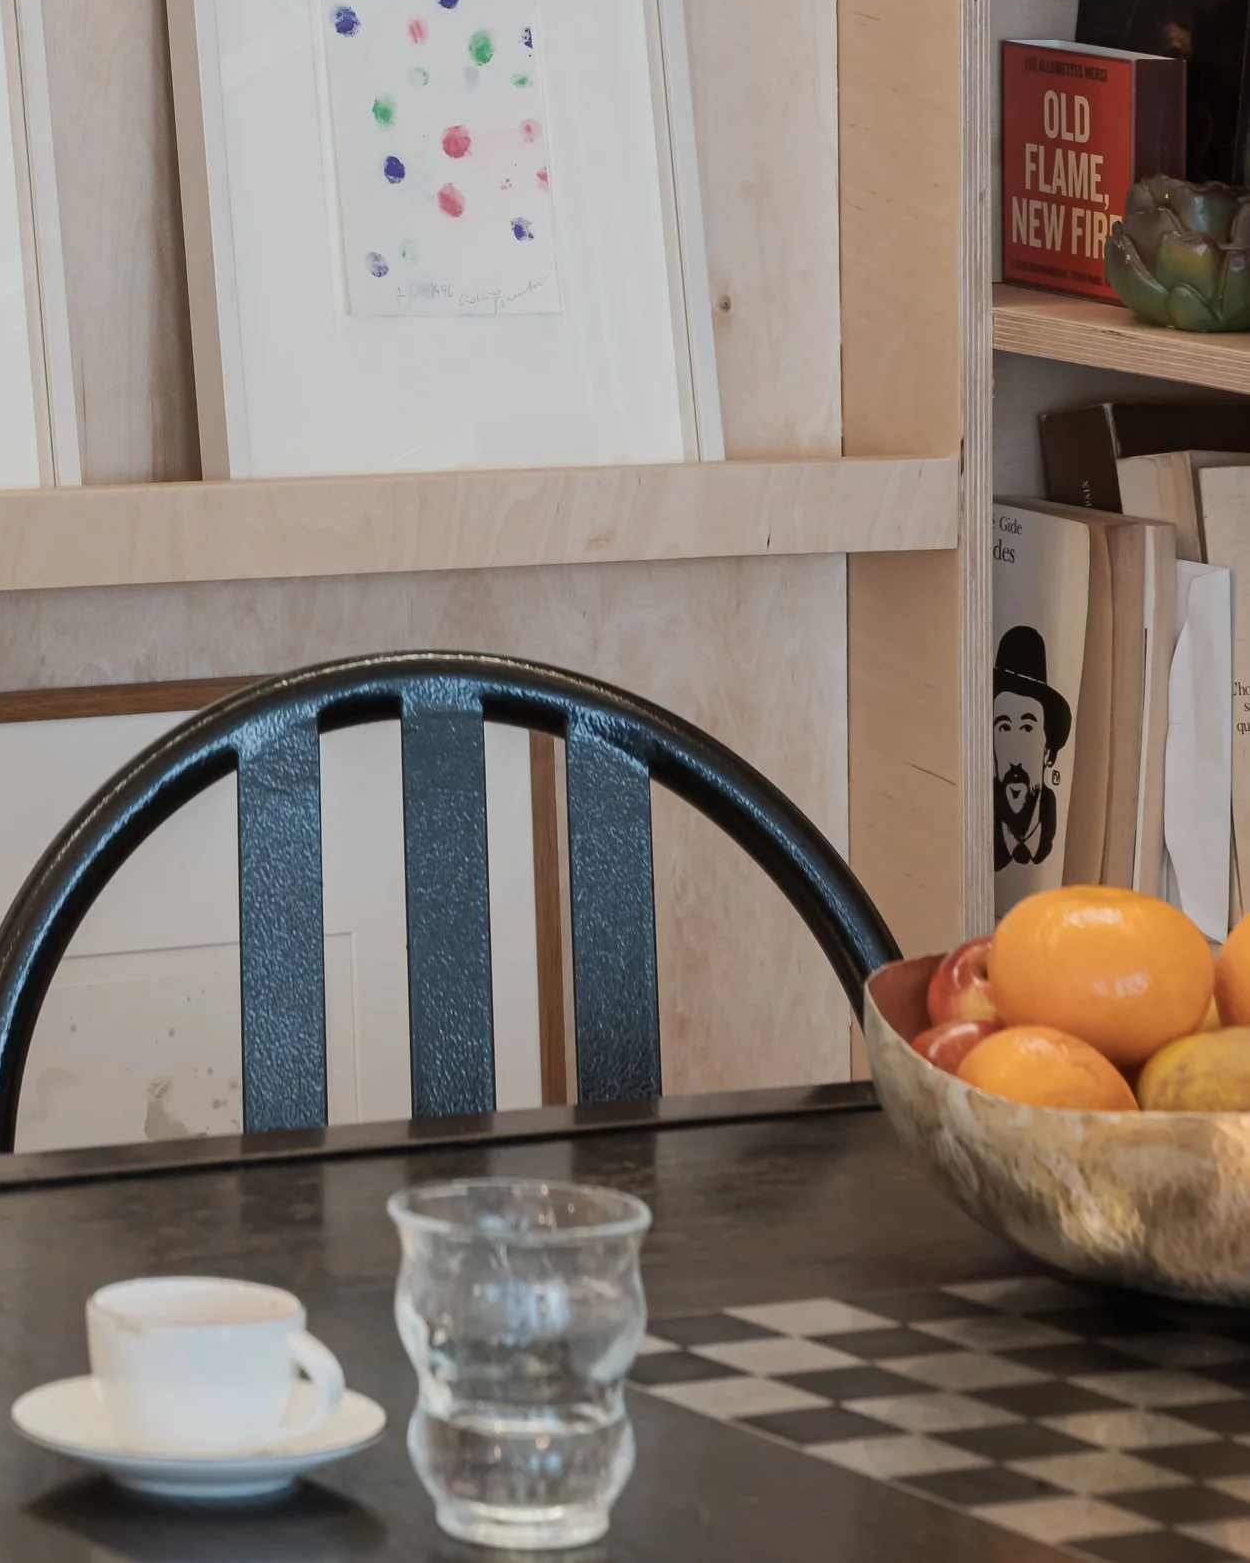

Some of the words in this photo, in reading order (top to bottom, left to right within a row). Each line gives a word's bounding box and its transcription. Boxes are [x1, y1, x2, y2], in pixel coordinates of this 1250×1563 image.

[1043, 89, 1091, 144] OLD
[1025, 142, 1110, 210] FLAME,
[1011, 196, 1066, 252] NEW
[993, 538, 1015, 564] des
[999, 515, 1023, 535] Gide
